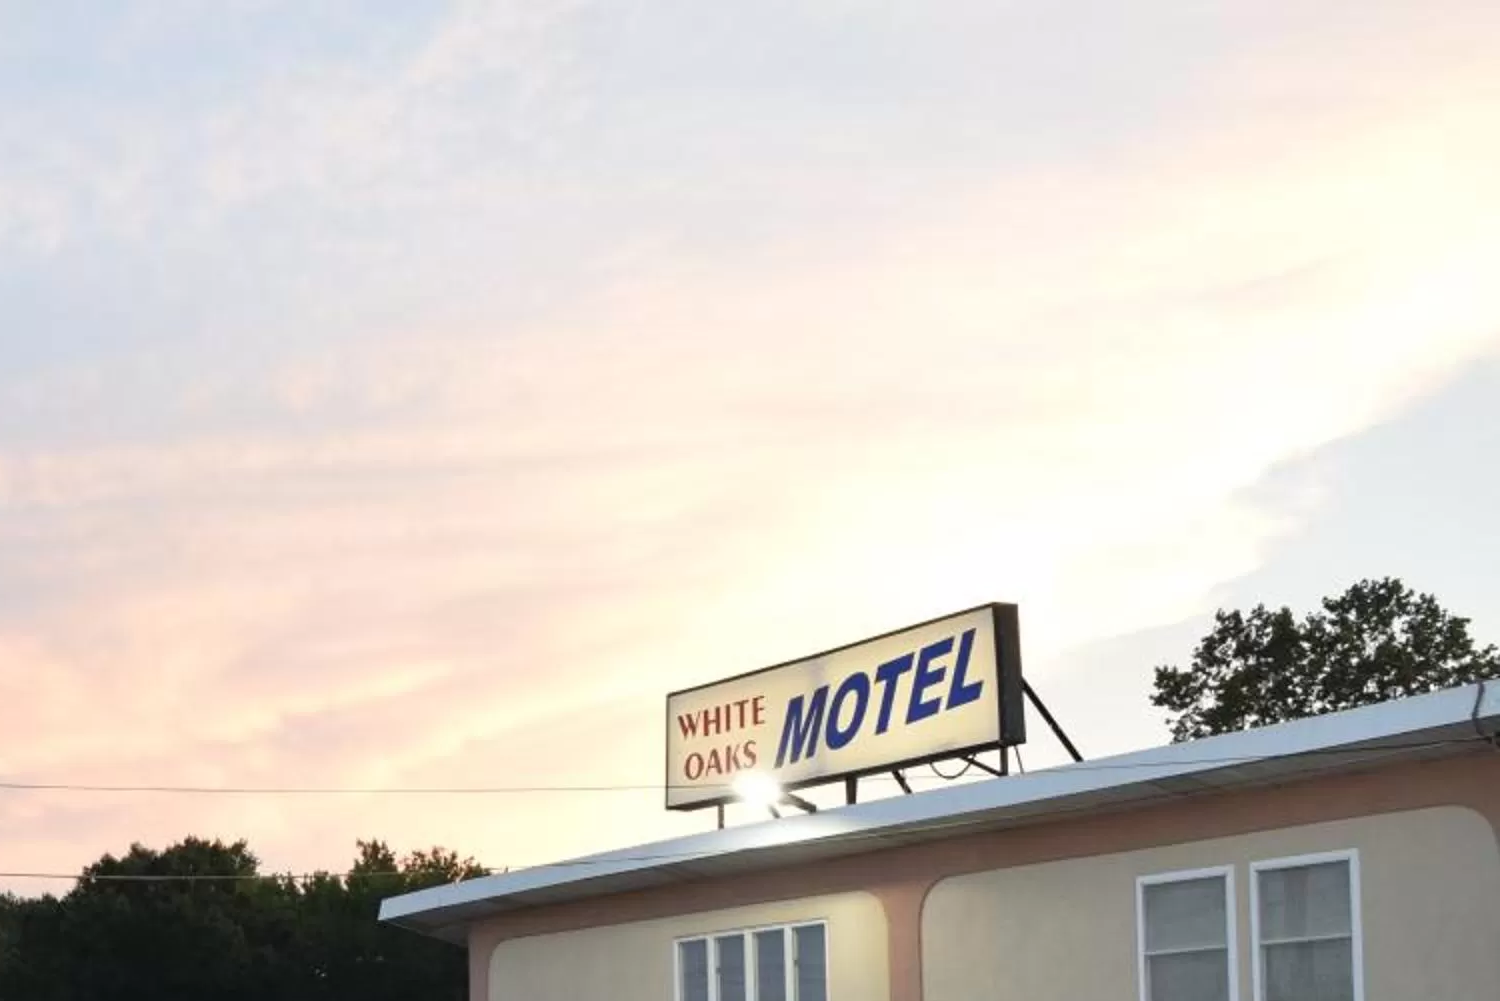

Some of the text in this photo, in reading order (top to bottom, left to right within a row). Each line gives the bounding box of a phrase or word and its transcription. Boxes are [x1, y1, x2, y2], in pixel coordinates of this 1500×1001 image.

[678, 695, 766, 740] WHITE
[774, 628, 984, 769] MOTEL
[684, 740, 757, 780] OAKS
